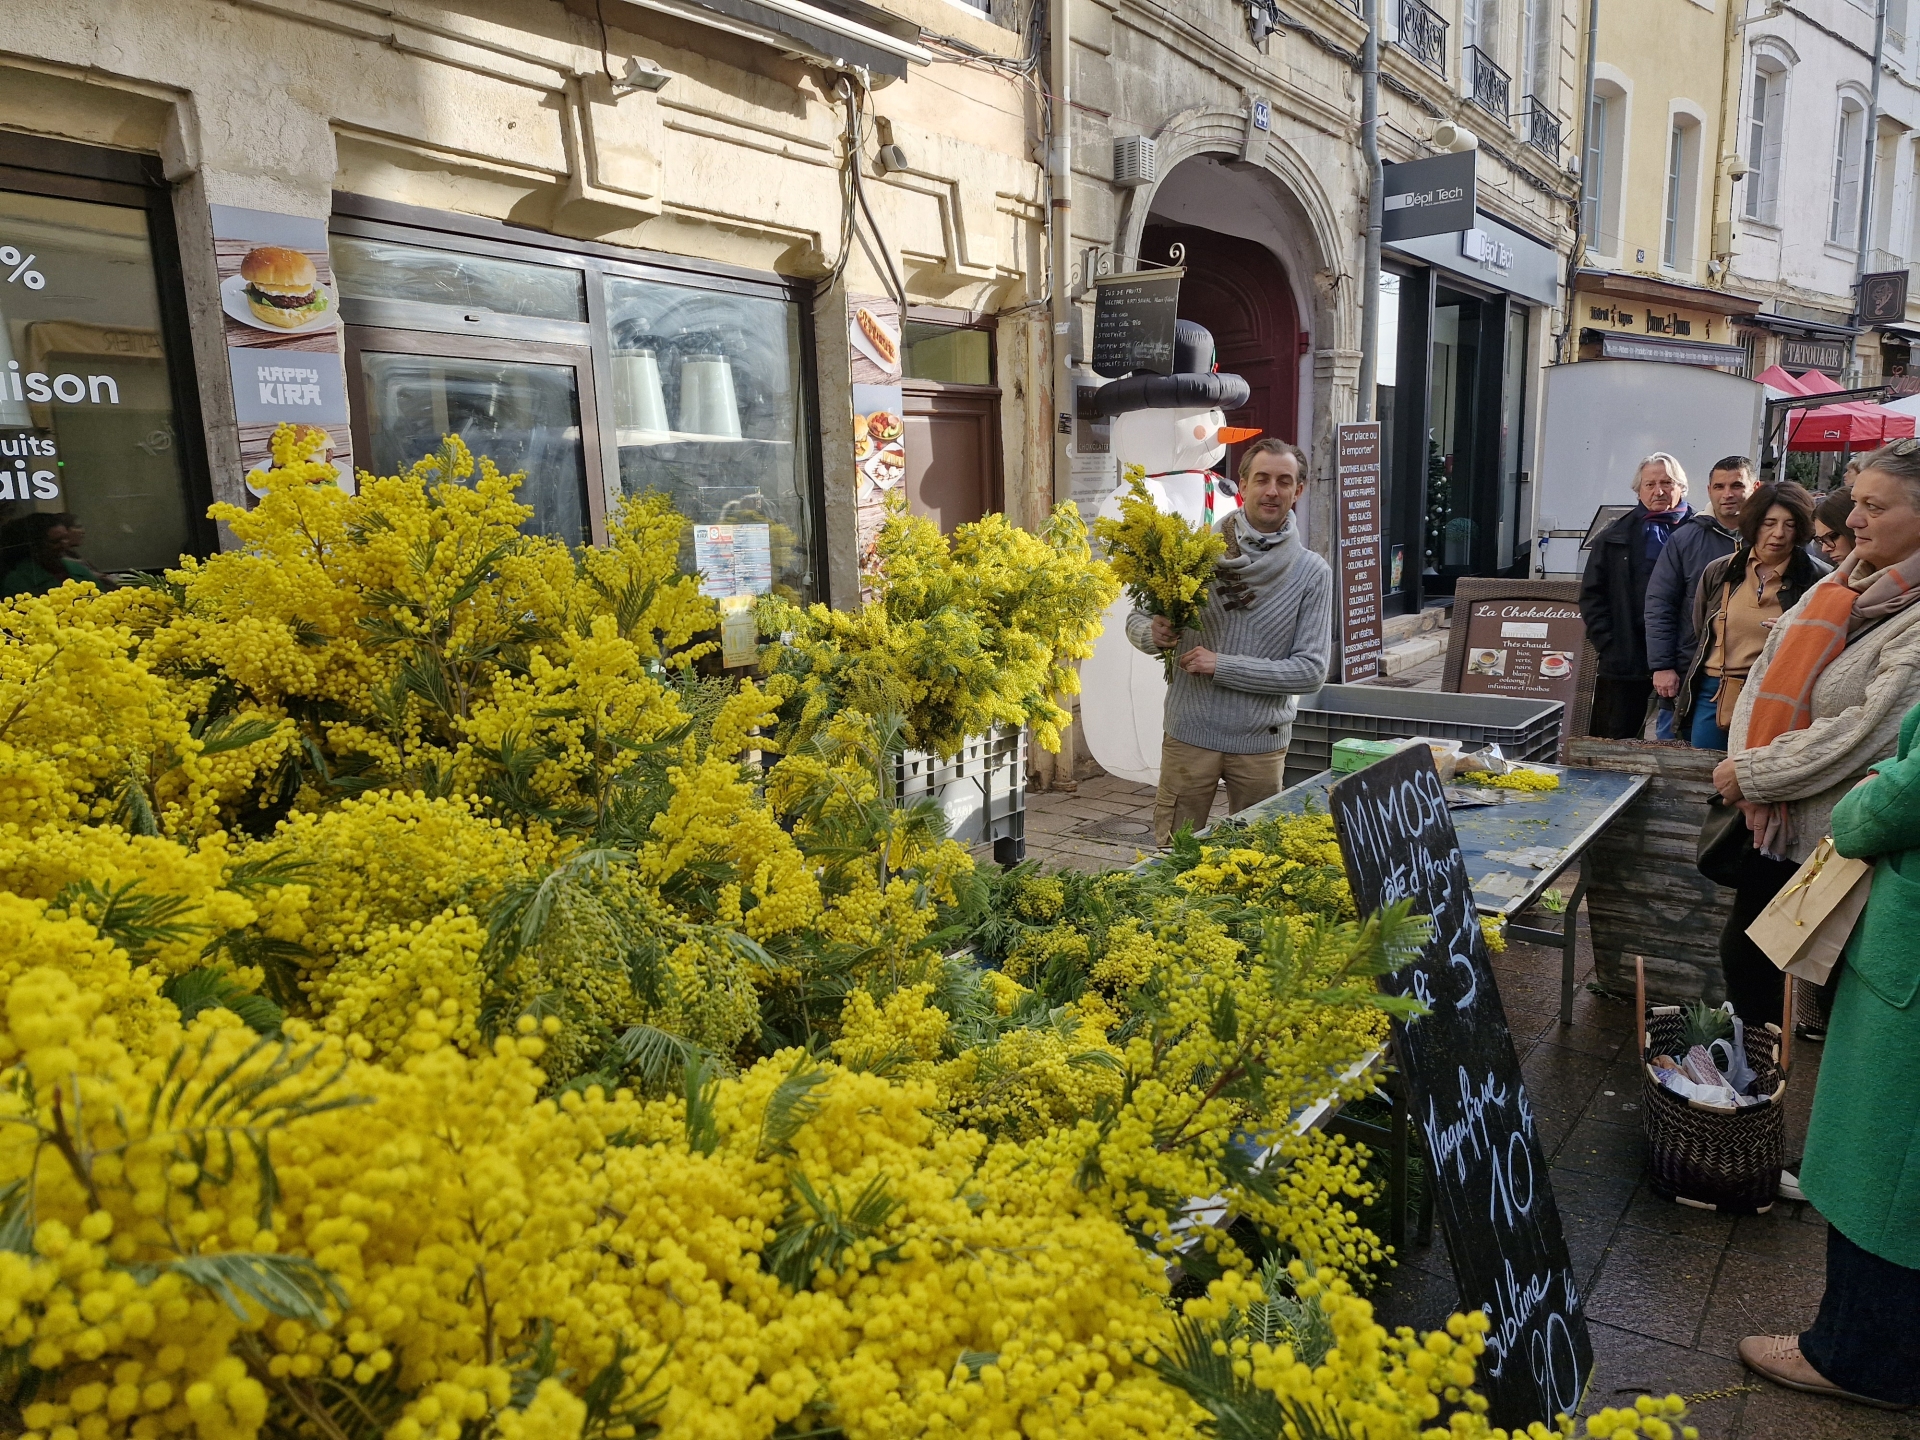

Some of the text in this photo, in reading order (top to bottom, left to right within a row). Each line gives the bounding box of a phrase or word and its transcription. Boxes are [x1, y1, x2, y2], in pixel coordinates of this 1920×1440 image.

[1256, 105, 1268, 127] 44
[1405, 191, 1433, 208] Dépil
[1436, 186, 1463, 201] Tech
[1498, 242, 1514, 269] Tech
[1787, 343, 1839, 367] TATOUAGE
[257, 366, 319, 383] HAPPY
[0, 360, 120, 404] ison
[259, 382, 322, 406] KIRA
[1354, 430, 1369, 443] place
[1370, 432, 1378, 440] ou
[1344, 476, 1376, 486] SMOOTHIE GREEN
[1348, 500, 1370, 510] MILKSHAKES
[1358, 524, 1372, 532] CHAUDS
[1348, 593, 1374, 606] GOLDEN LATTE
[1474, 605, 1582, 619] La Chokolateri
[1348, 616, 1360, 626] chaud
[1366, 613, 1376, 624] froid
[1344, 642, 1364, 654] BOISSONS
[1502, 640, 1551, 649] Thés chauds
[1362, 662, 1376, 672] FRUITS
[1490, 1131, 1533, 1232] 10
